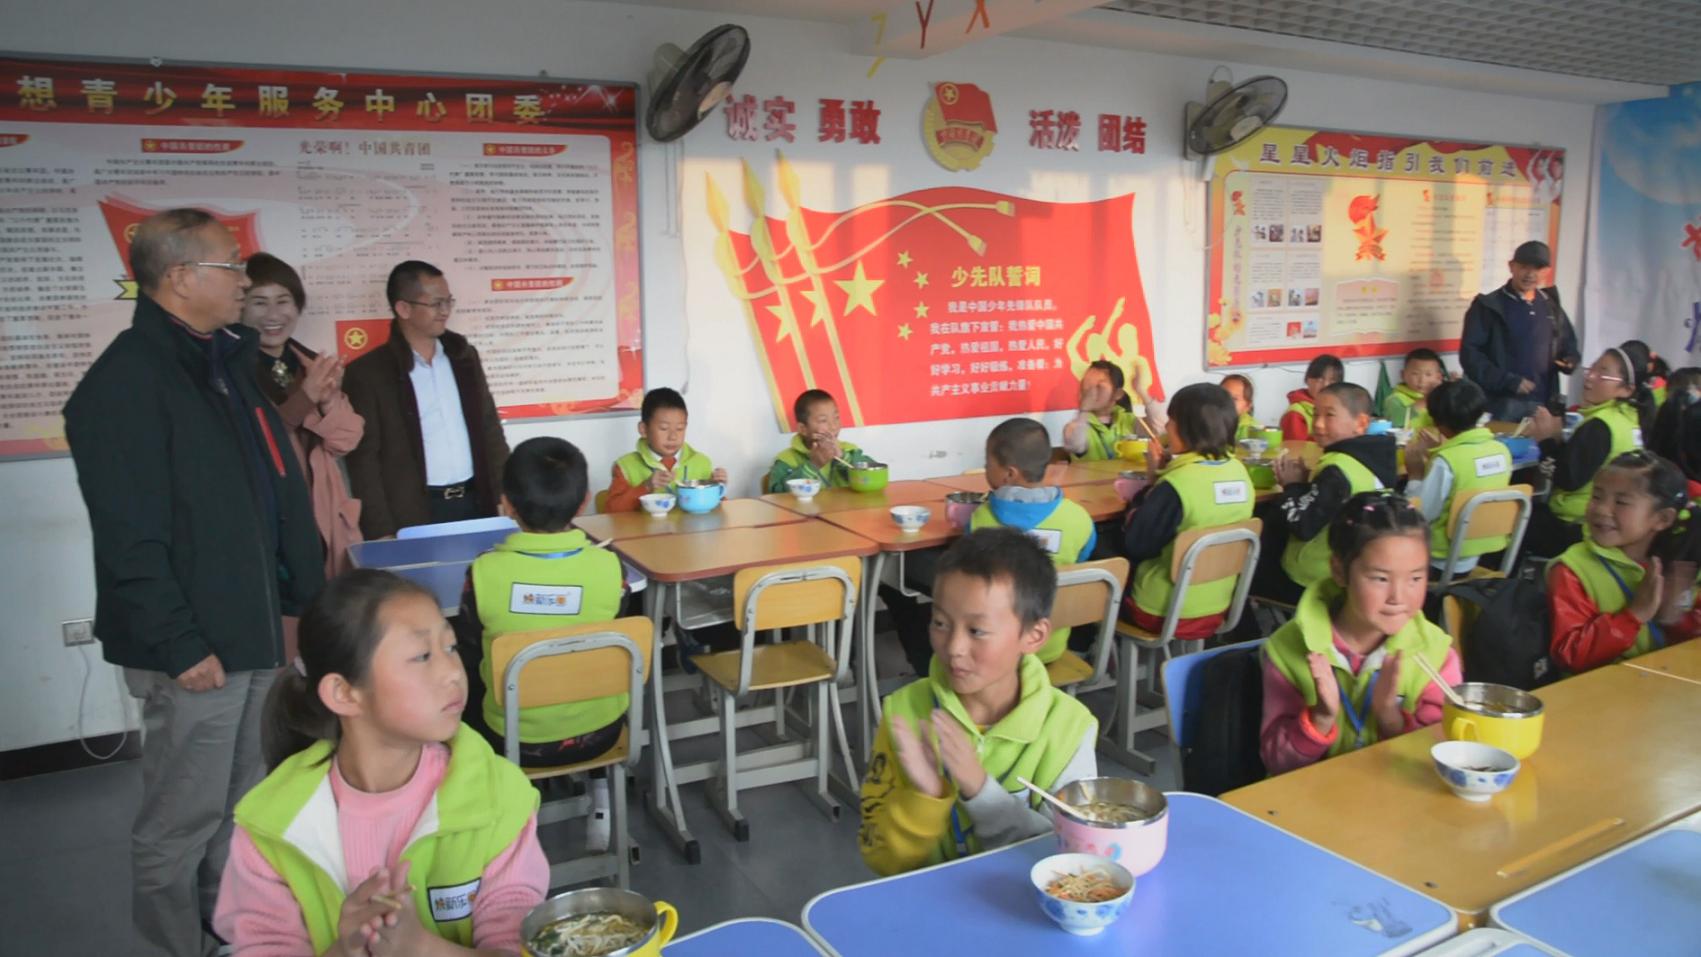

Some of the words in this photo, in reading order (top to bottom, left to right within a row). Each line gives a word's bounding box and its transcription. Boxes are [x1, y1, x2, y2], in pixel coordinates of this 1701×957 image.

[17, 76, 545, 126] 想青少年服务中心团委
[723, 94, 796, 142] 诚实
[817, 98, 881, 144] 勇敢
[1029, 110, 1081, 152] 活泼
[1097, 113, 1147, 154] 团结
[1259, 143, 1517, 178] 星星火炬指引我们前进
[951, 265, 1041, 288] 少先队誓词
